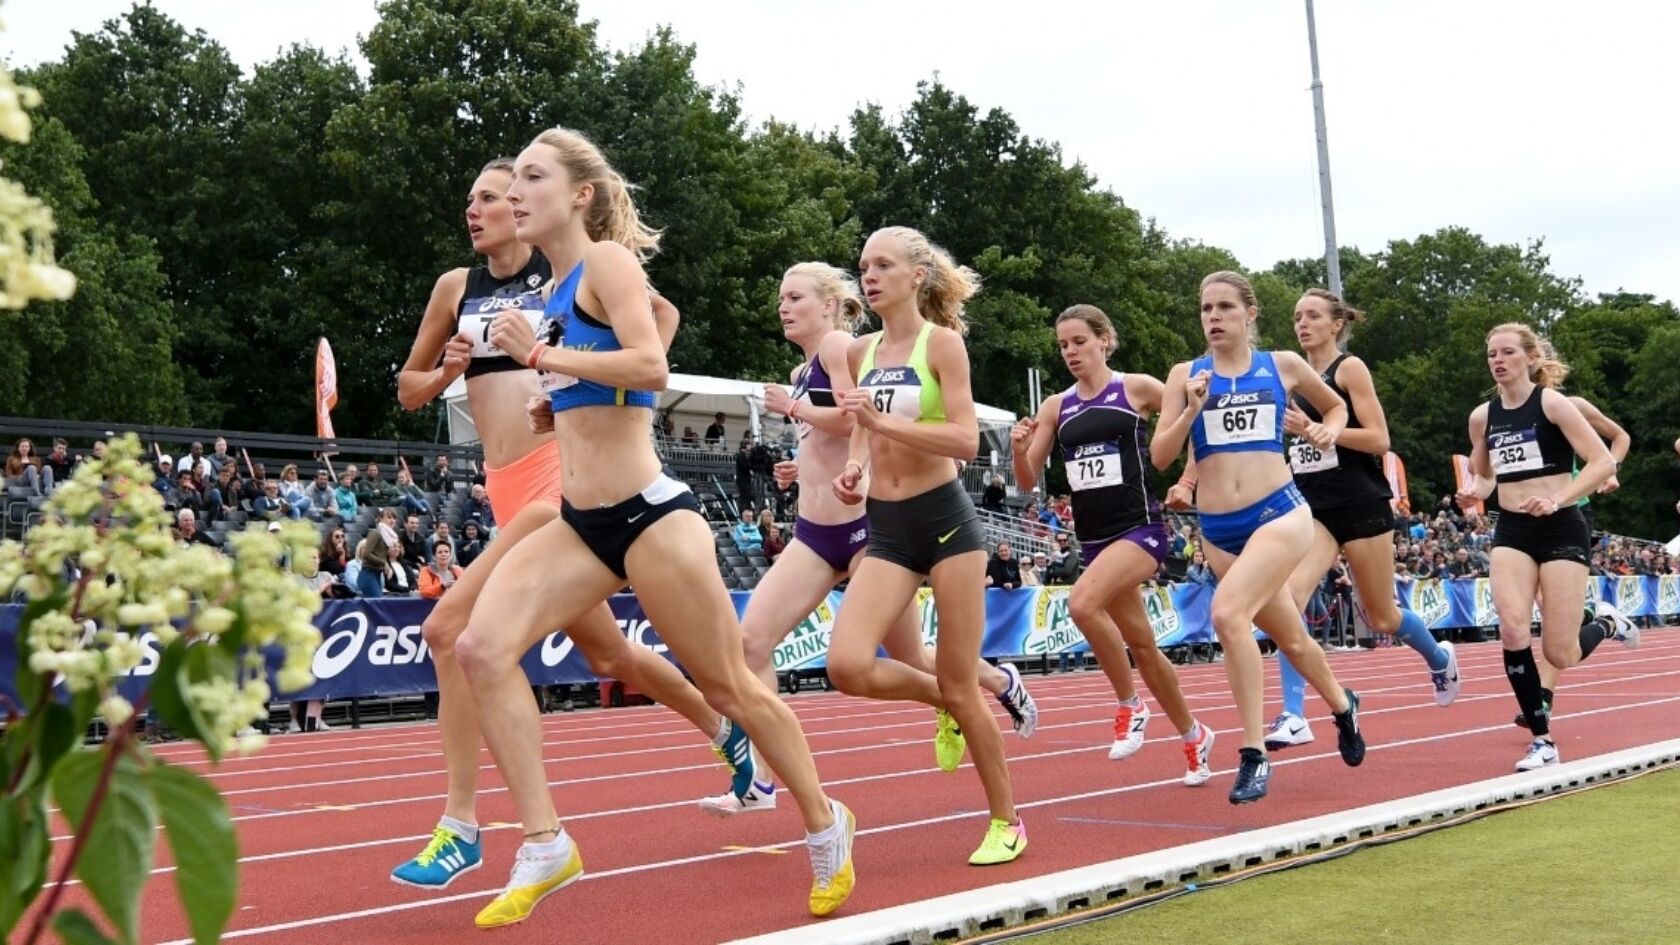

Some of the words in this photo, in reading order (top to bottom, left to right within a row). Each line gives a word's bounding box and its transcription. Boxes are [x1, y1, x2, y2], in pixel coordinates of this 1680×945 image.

[1223, 408, 1258, 433] 667
[1500, 446, 1527, 464] 352
[1078, 459, 1105, 480] 712
[368, 625, 433, 665] asi
[773, 631, 829, 668] DRINK
[1047, 624, 1082, 652] DRIN
